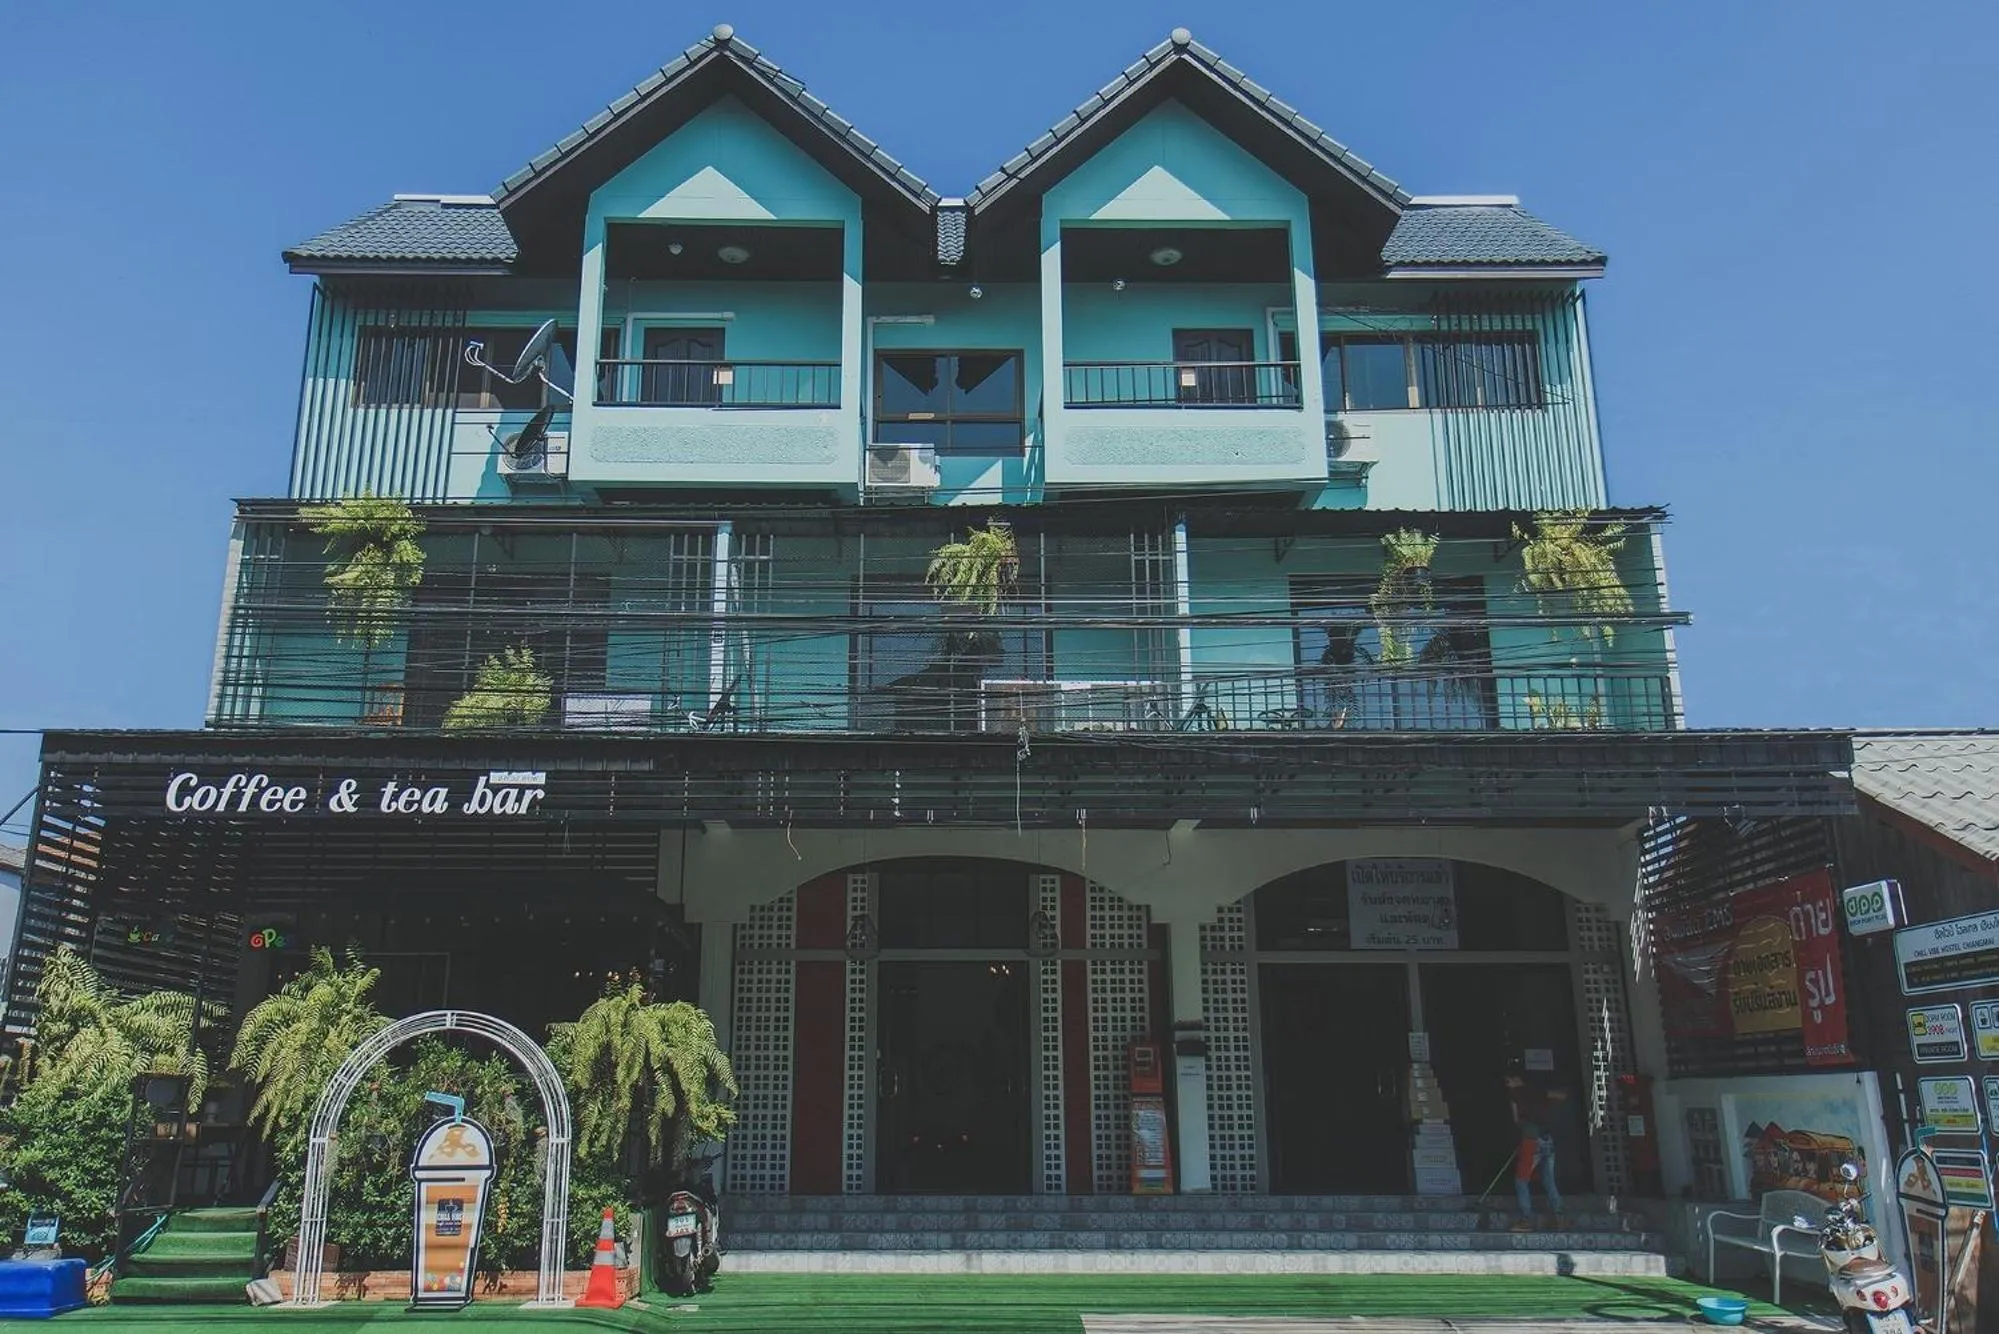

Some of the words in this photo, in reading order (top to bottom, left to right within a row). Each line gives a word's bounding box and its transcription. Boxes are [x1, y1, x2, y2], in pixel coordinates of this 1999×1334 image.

[165, 772, 308, 813] Coffee
[329, 778, 360, 813] &
[380, 778, 449, 814] tea
[463, 775, 545, 815] bar
[1789, 890, 1833, 941] ถ่าย
[1805, 953, 1837, 1024] รูป
